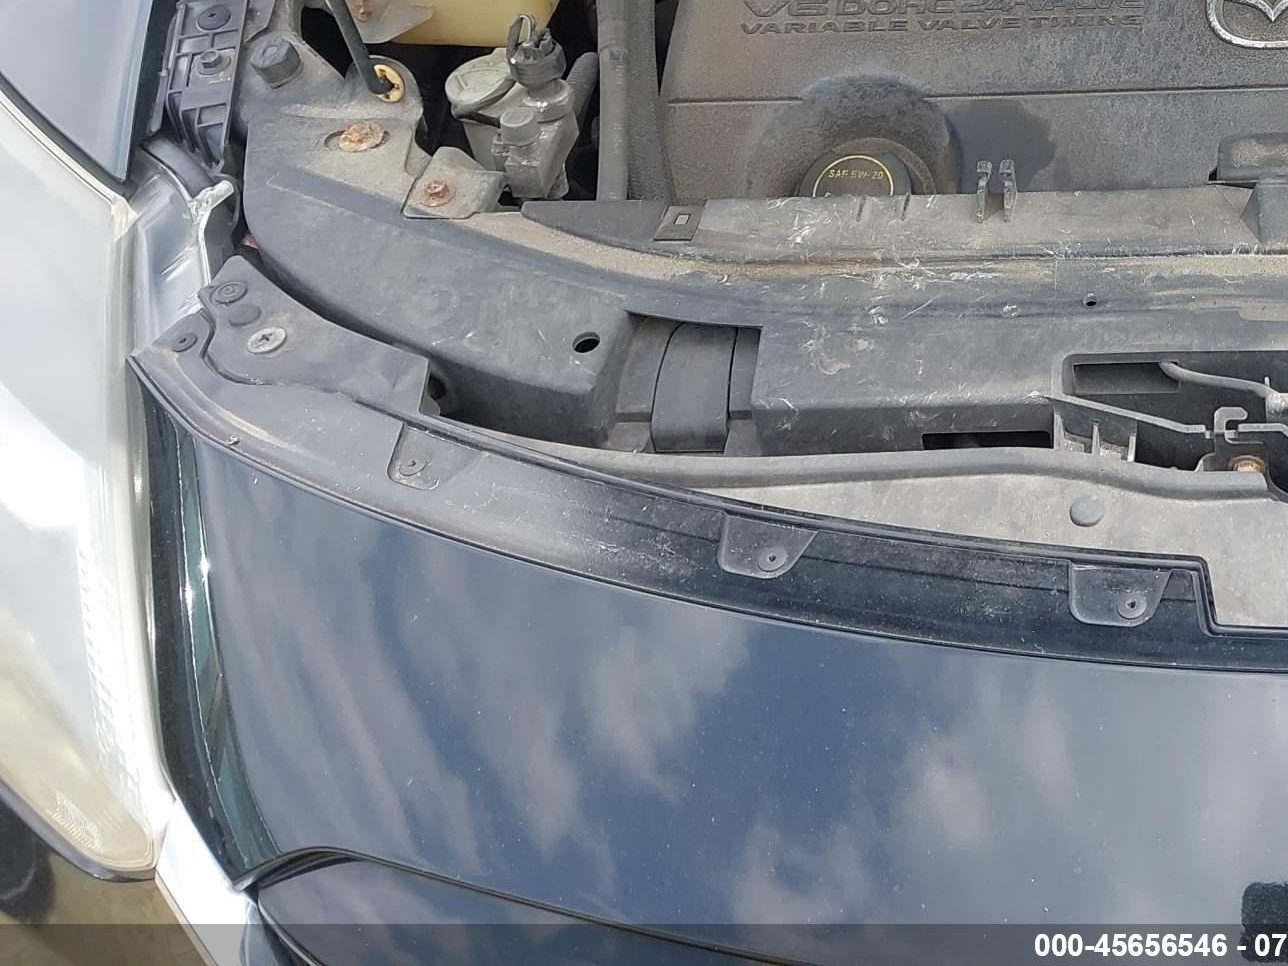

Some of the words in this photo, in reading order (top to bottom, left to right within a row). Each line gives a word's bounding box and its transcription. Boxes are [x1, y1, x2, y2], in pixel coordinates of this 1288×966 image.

[740, 19, 908, 35] VARIABLE
[917, 17, 1021, 31] VALVE
[1028, 15, 1143, 28] TIMING
[828, 169, 849, 179] SAE
[850, 169, 884, 180] 5W-20
